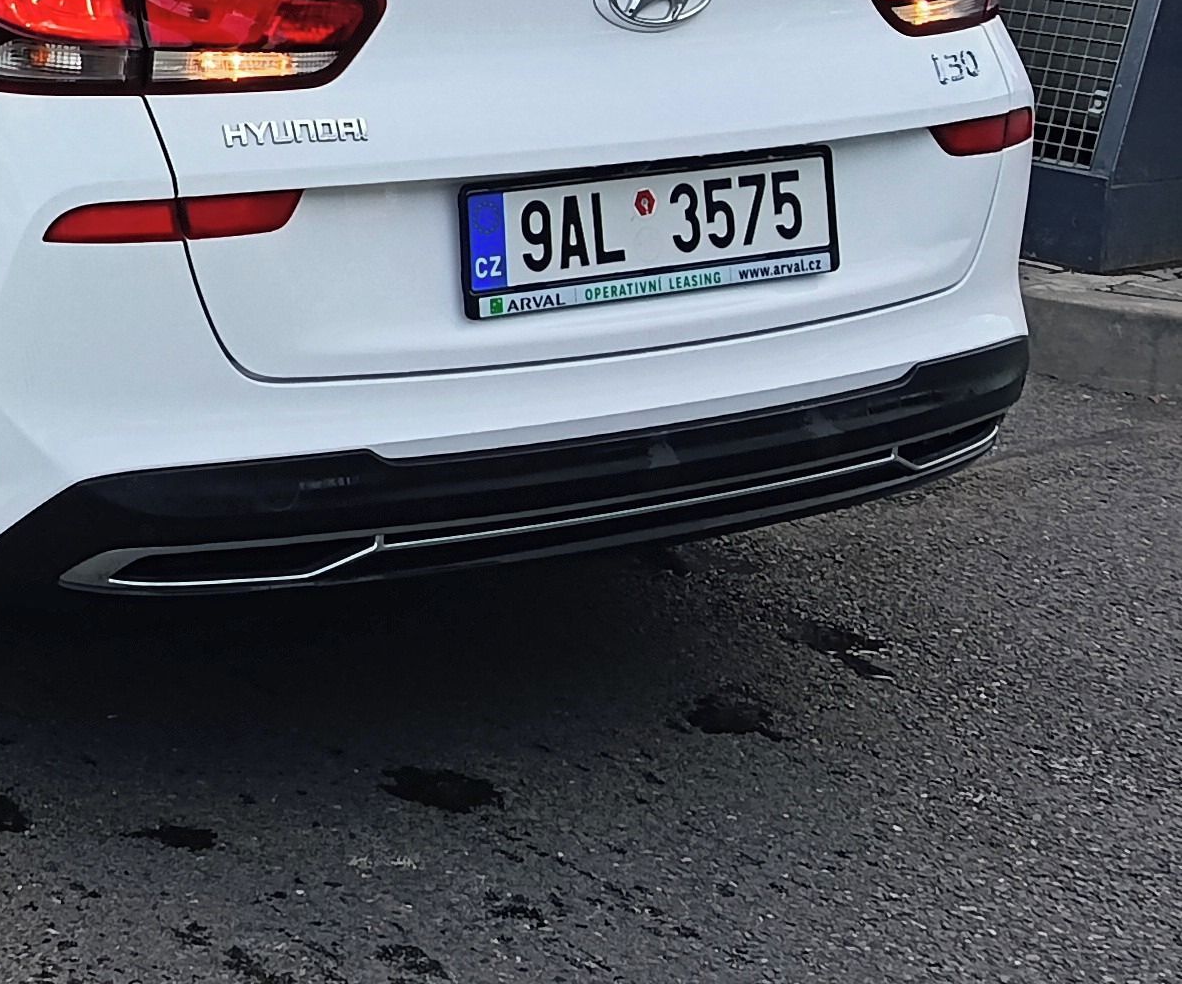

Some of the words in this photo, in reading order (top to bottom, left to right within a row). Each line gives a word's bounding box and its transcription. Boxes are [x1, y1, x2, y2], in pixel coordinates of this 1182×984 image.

[222, 117, 368, 148] HYUNDAI
[521, 192, 626, 272] 9AL
[669, 169, 803, 253] 3575
[474, 255, 503, 279] CZ
[507, 293, 566, 313] ARVAL
[585, 275, 662, 301] OPERATIVNÍ
[669, 271, 721, 290] LEASING
[739, 259, 821, 280] www.arval.cz
